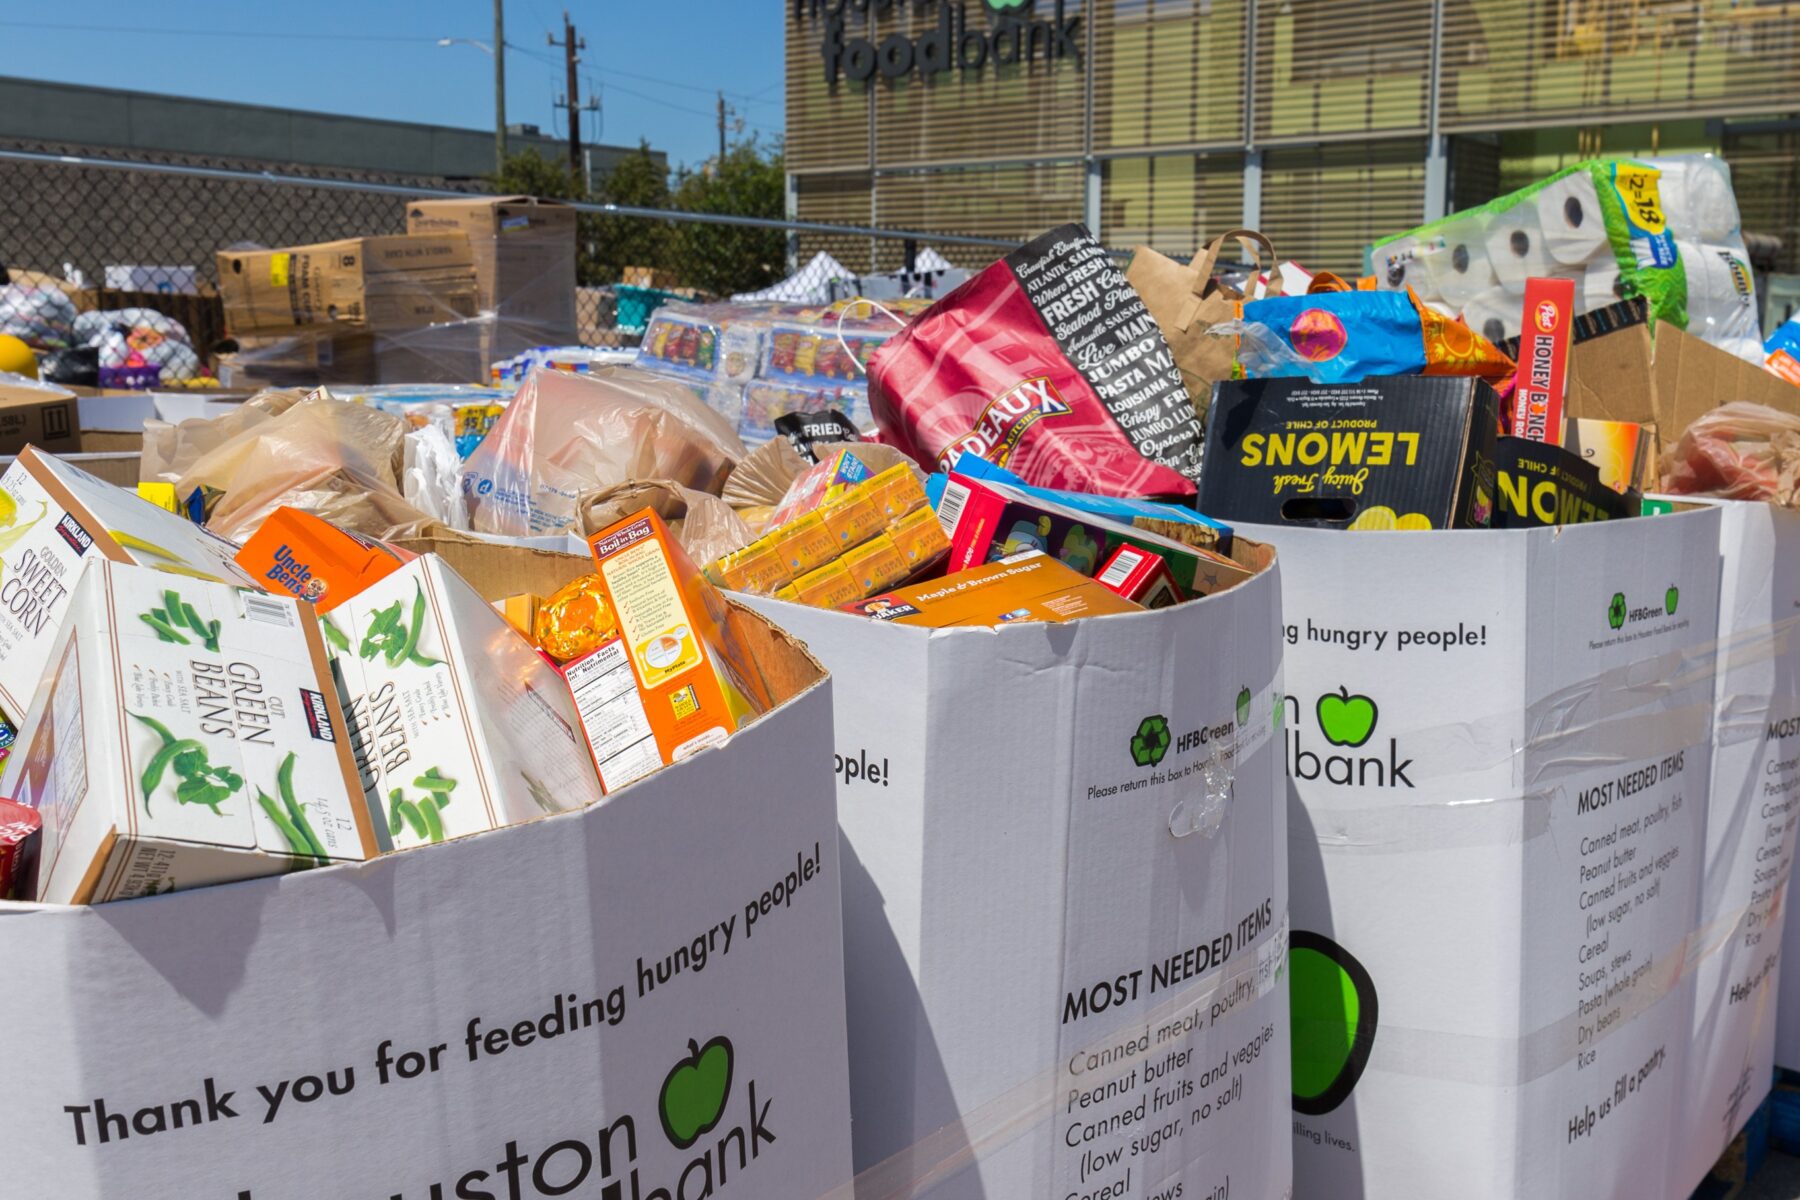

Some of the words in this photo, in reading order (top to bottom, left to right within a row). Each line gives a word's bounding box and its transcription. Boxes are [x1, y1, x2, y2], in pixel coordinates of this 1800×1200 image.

[1026, 260, 1069, 292] ATLANTIC
[1065, 257, 1104, 287] FRESH
[1041, 281, 1101, 327] FRESH
[1537, 301, 1557, 331] Post
[1055, 306, 1101, 341] Seafood
[1077, 342, 1116, 371] Live
[1115, 312, 1158, 347] MAIN
[1088, 337, 1156, 383] JUMBO
[1533, 334, 1554, 391] HONEY
[1097, 368, 1146, 400] PASTA
[1106, 376, 1169, 415] LOUISIANA
[1164, 388, 1190, 409] FRI
[803, 422, 842, 438] FRIED
[1006, 407, 1042, 445] KITCHEN
[1130, 414, 1174, 445] JUMBO
[1286, 421, 1313, 430] CHILE
[1316, 420, 1329, 429] OF
[1331, 420, 1377, 429] PRODUCT
[1140, 429, 1193, 457] Oysters
[1240, 432, 1420, 468] LEMONS
[1273, 473, 1319, 494] Fresh
[1322, 466, 1369, 495] Juicy
[61, 514, 92, 548] KIRKLAND
[40, 546, 67, 577] GOLDEN
[265, 563, 304, 594] Ben's
[273, 543, 312, 583] Uncle
[14, 548, 67, 611] SWEET
[917, 586, 954, 602] Maple
[956, 582, 967, 592] &
[968, 573, 1004, 591] Brown
[1005, 561, 1042, 578] Sugar
[1, 578, 51, 639] CORN
[1307, 618, 1388, 651] hungry
[1398, 622, 1486, 651] people!
[567, 658, 595, 675] Nutrition
[596, 646, 616, 658] Facts
[190, 659, 236, 739] BEANS
[227, 662, 275, 747] GREEN
[268, 696, 285, 718] CUT
[310, 693, 334, 741] KIRKLAND
[369, 681, 411, 775] BEANS
[834, 748, 889, 787] ople!
[1285, 728, 1415, 788] bank
[1088, 784, 1117, 800] Please
[1120, 777, 1147, 793] return
[1150, 772, 1165, 787] this
[1168, 769, 1183, 782] box
[1184, 766, 1192, 777] to
[1577, 781, 1614, 816] MOST
[1616, 764, 1657, 800] NEEDED
[1660, 750, 1684, 783] ITEMS
[1580, 824, 1617, 856] Canned
[1579, 855, 1611, 884] Peanut
[1579, 878, 1615, 910] Canned
[1638, 856, 1653, 878] and
[1634, 893, 1646, 908] no
[1062, 969, 1143, 1025] MOST
[1150, 932, 1232, 994] NEEDED
[1237, 897, 1271, 951] ITEMS
[1578, 931, 1609, 964] Cereal
[1610, 950, 1632, 972] stews
[64, 1077, 240, 1146] Thank
[255, 1066, 356, 1125] you
[375, 1040, 448, 1085] for
[465, 985, 626, 1062] feeding
[636, 914, 737, 998] hungry
[744, 842, 821, 938] people!
[1578, 994, 1602, 1018] Pasta
[1069, 1024, 1149, 1076] Canned
[1157, 1008, 1203, 1044] meat,
[1210, 977, 1254, 1027] poultry,
[1577, 1026, 1594, 1046] Dry
[1597, 1006, 1621, 1033] beans
[1578, 1049, 1596, 1071] Rice
[1065, 1094, 1146, 1148] Canned
[1153, 1079, 1194, 1113] fruits
[1200, 1051, 1228, 1089] and
[1232, 1023, 1274, 1068] veggies
[1067, 1070, 1136, 1114] Peanut
[1144, 1048, 1194, 1084] butter
[1568, 1105, 1596, 1144] Help
[1599, 1097, 1611, 1119] us
[1613, 1073, 1627, 1107] fill
[1628, 1076, 1636, 1094] a
[1080, 1146, 1124, 1184] (low
[1130, 1118, 1184, 1157] sugar,
[1191, 1104, 1212, 1125] no
[1216, 1074, 1243, 1110] salt)
[1324, 1130, 1355, 1152] lives.
